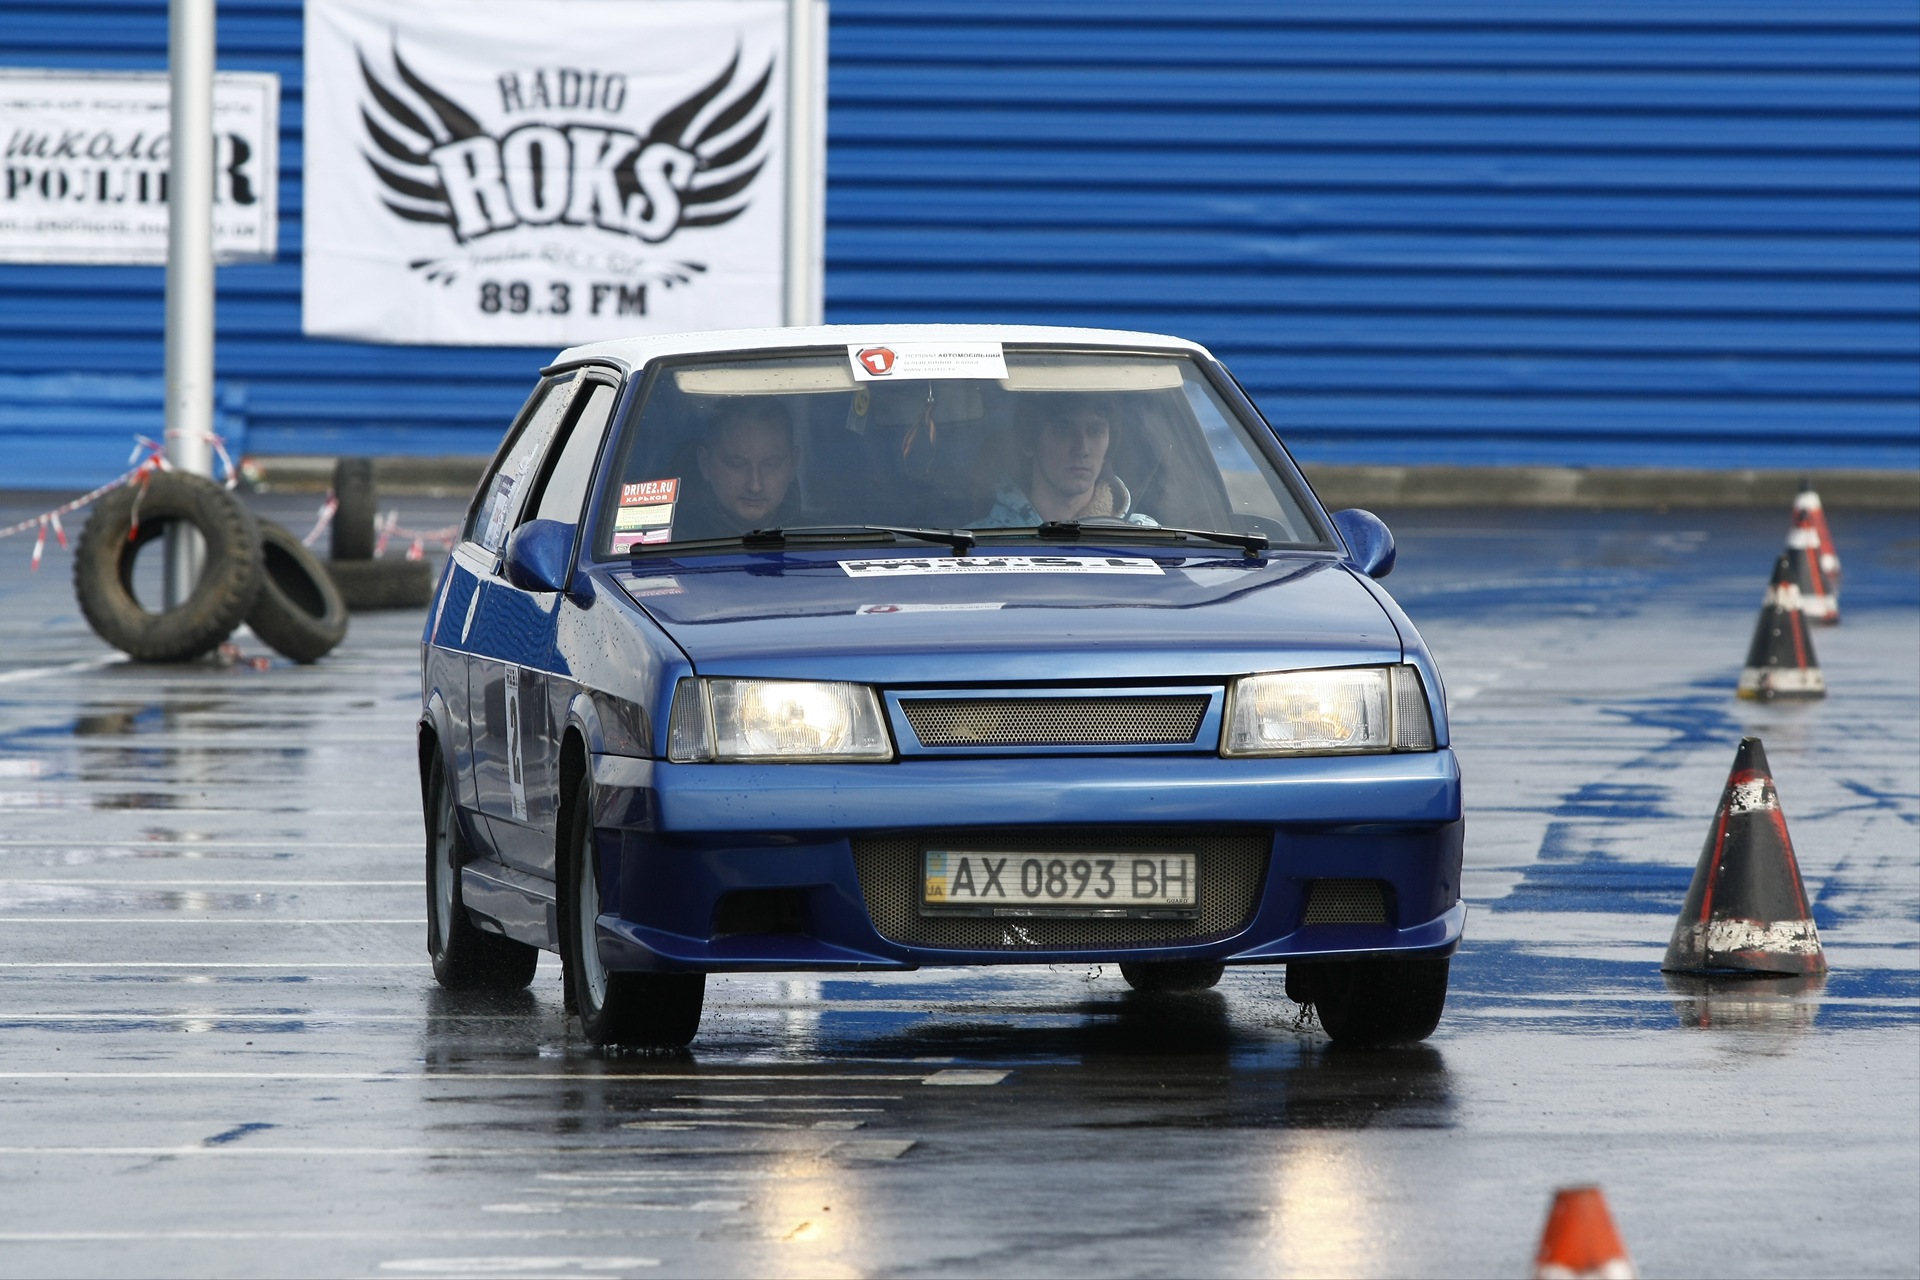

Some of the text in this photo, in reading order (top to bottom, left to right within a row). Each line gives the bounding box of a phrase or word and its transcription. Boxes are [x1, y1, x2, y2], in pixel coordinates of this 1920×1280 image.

[497, 67, 626, 113] RADIO
[5, 167, 170, 204] РОЛЛ
[429, 124, 700, 244] ROKS
[480, 281, 649, 316] 89.3 FM
[624, 481, 674, 496] DRIVE2.RU
[625, 494, 668, 503] ХАРЬКОВ
[926, 885, 943, 897] UA
[950, 857, 1188, 899] AX 0893 BH
